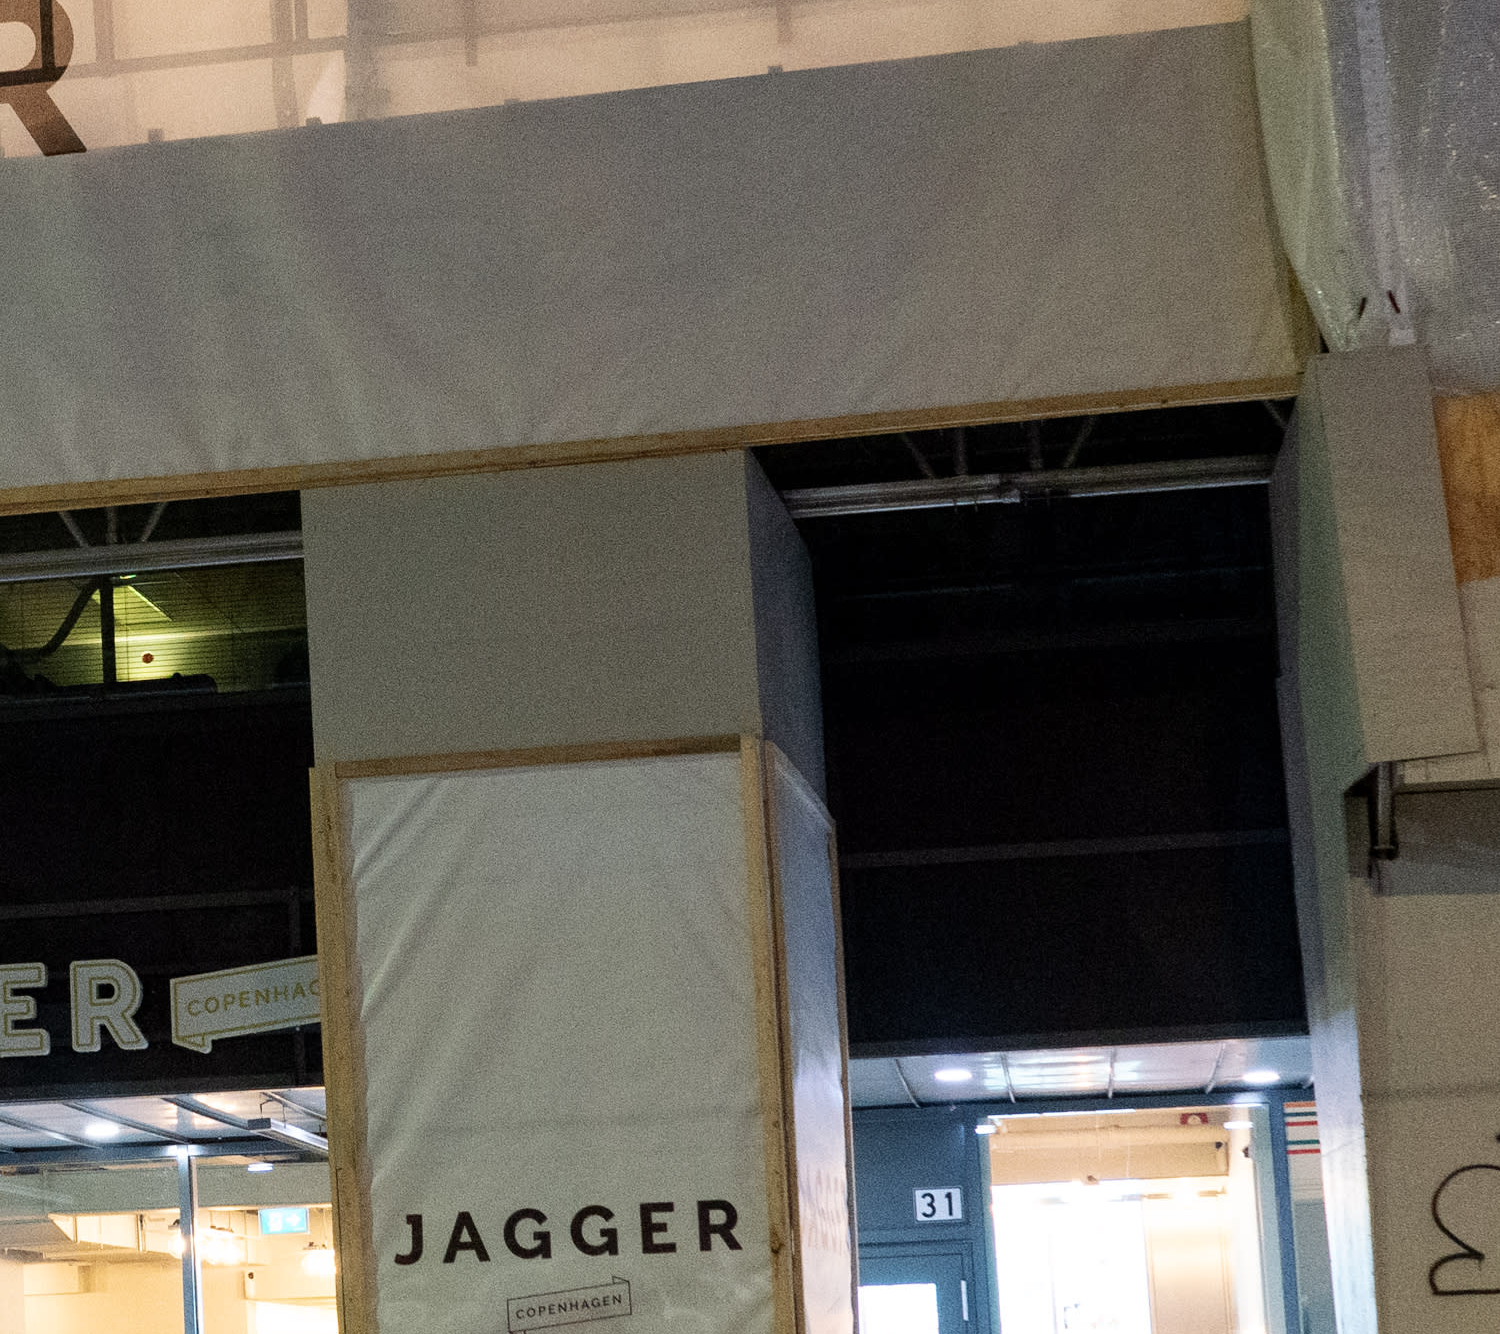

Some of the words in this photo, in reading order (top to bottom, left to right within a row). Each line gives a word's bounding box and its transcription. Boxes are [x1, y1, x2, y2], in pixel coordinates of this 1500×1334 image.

[921, 1191, 954, 1218] 31
[394, 1199, 744, 1266] JAGGER
[515, 1293, 624, 1322] COPENHAGEN
